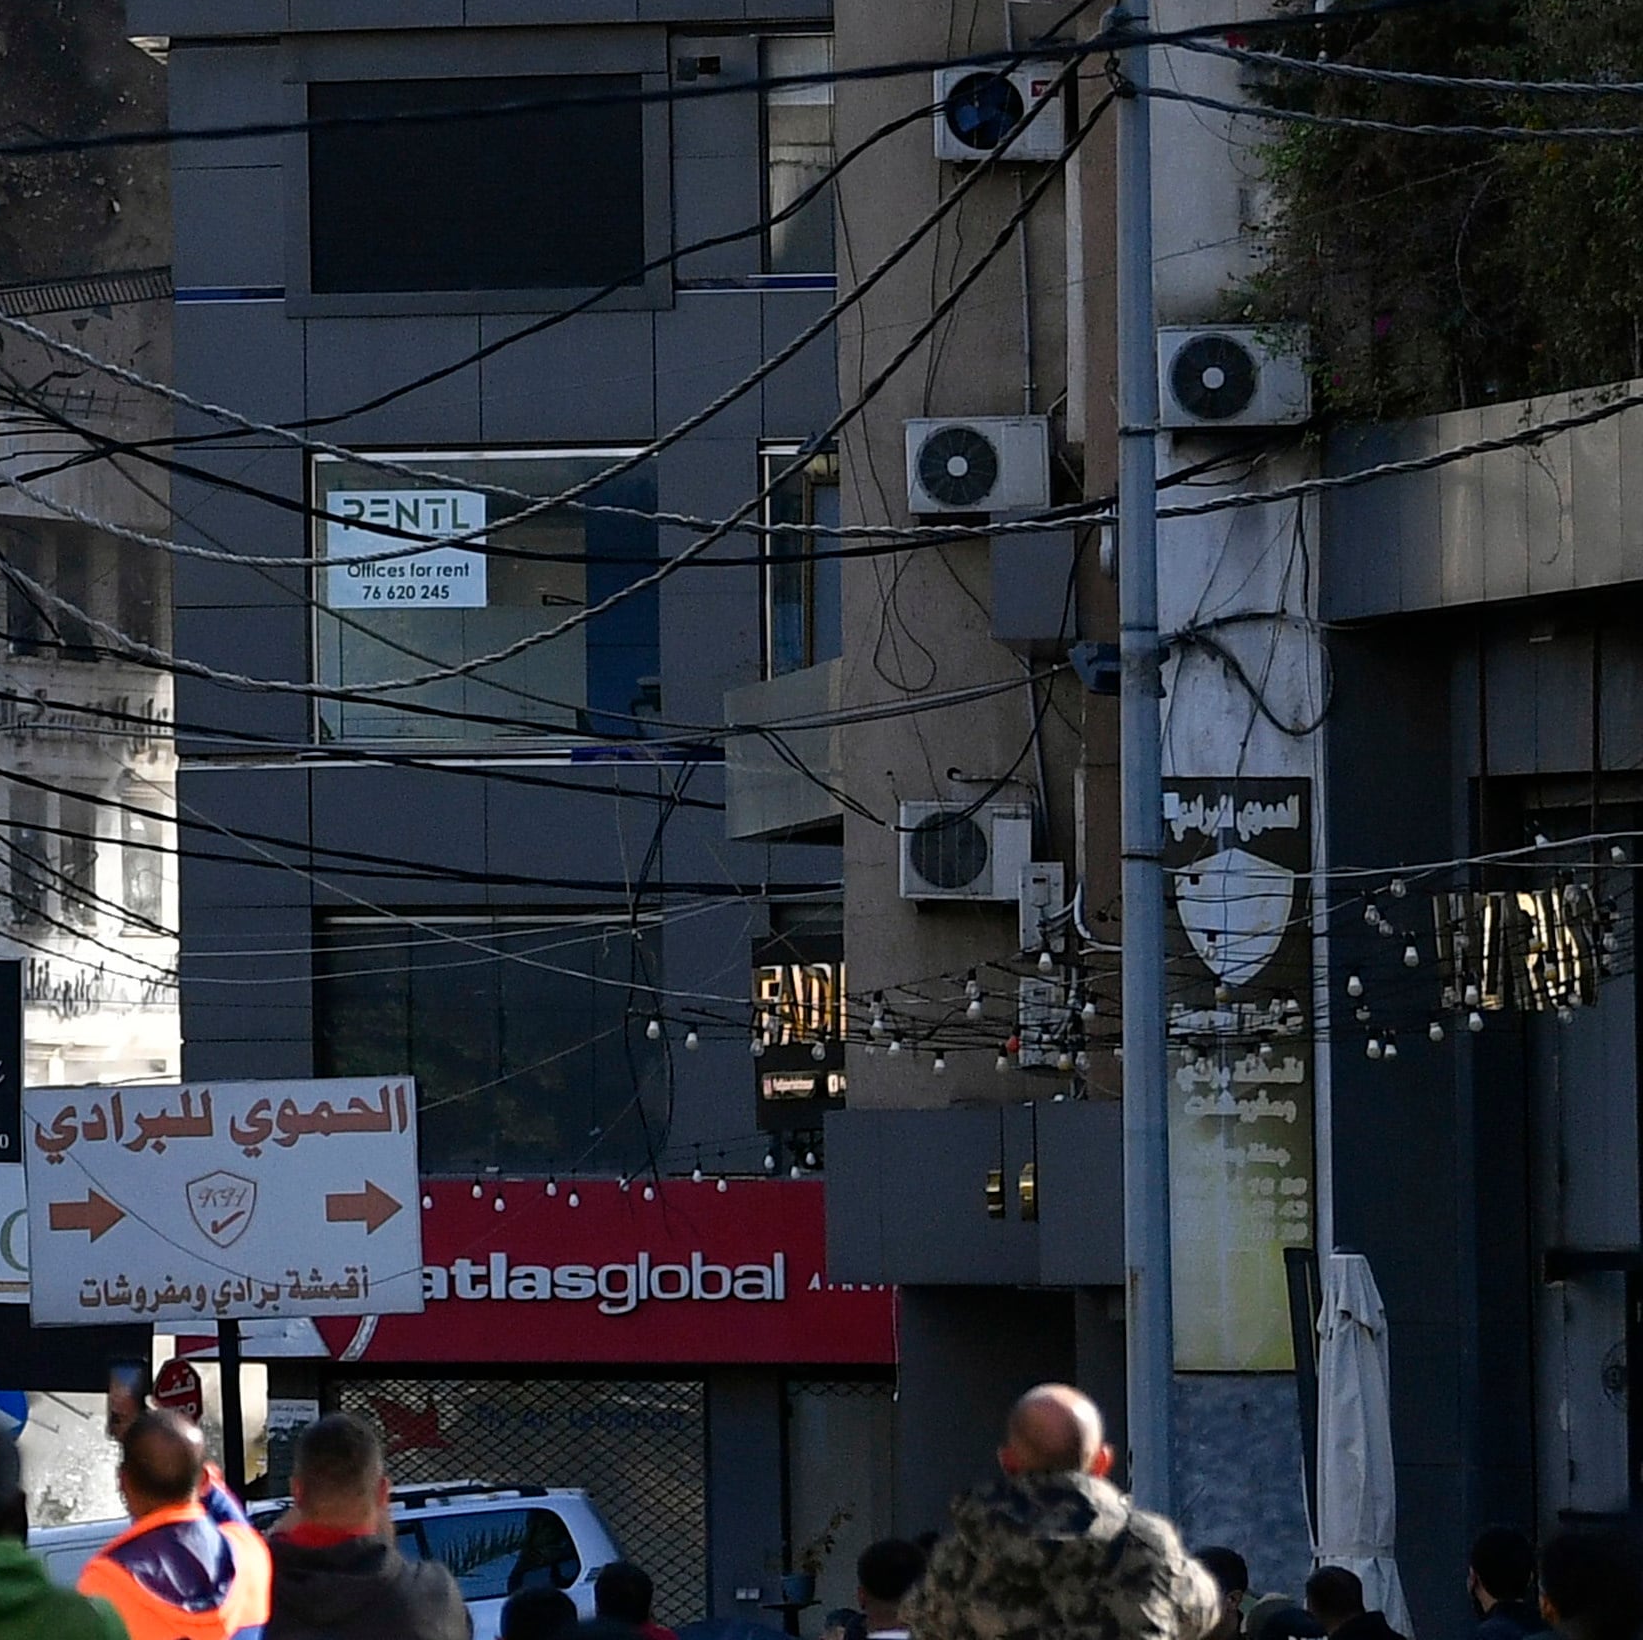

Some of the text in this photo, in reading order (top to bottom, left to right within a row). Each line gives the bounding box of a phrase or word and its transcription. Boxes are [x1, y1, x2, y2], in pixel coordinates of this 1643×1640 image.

[347, 562, 471, 578] Offices for rent
[362, 585, 450, 600] 76 620 245
[34, 1084, 409, 1165] الحموي للبرادي
[78, 1265, 371, 1314] أقمشة برادي ومفروشات
[421, 1251, 785, 1315] atlasglobal
[158, 1368, 196, 1398] قف
